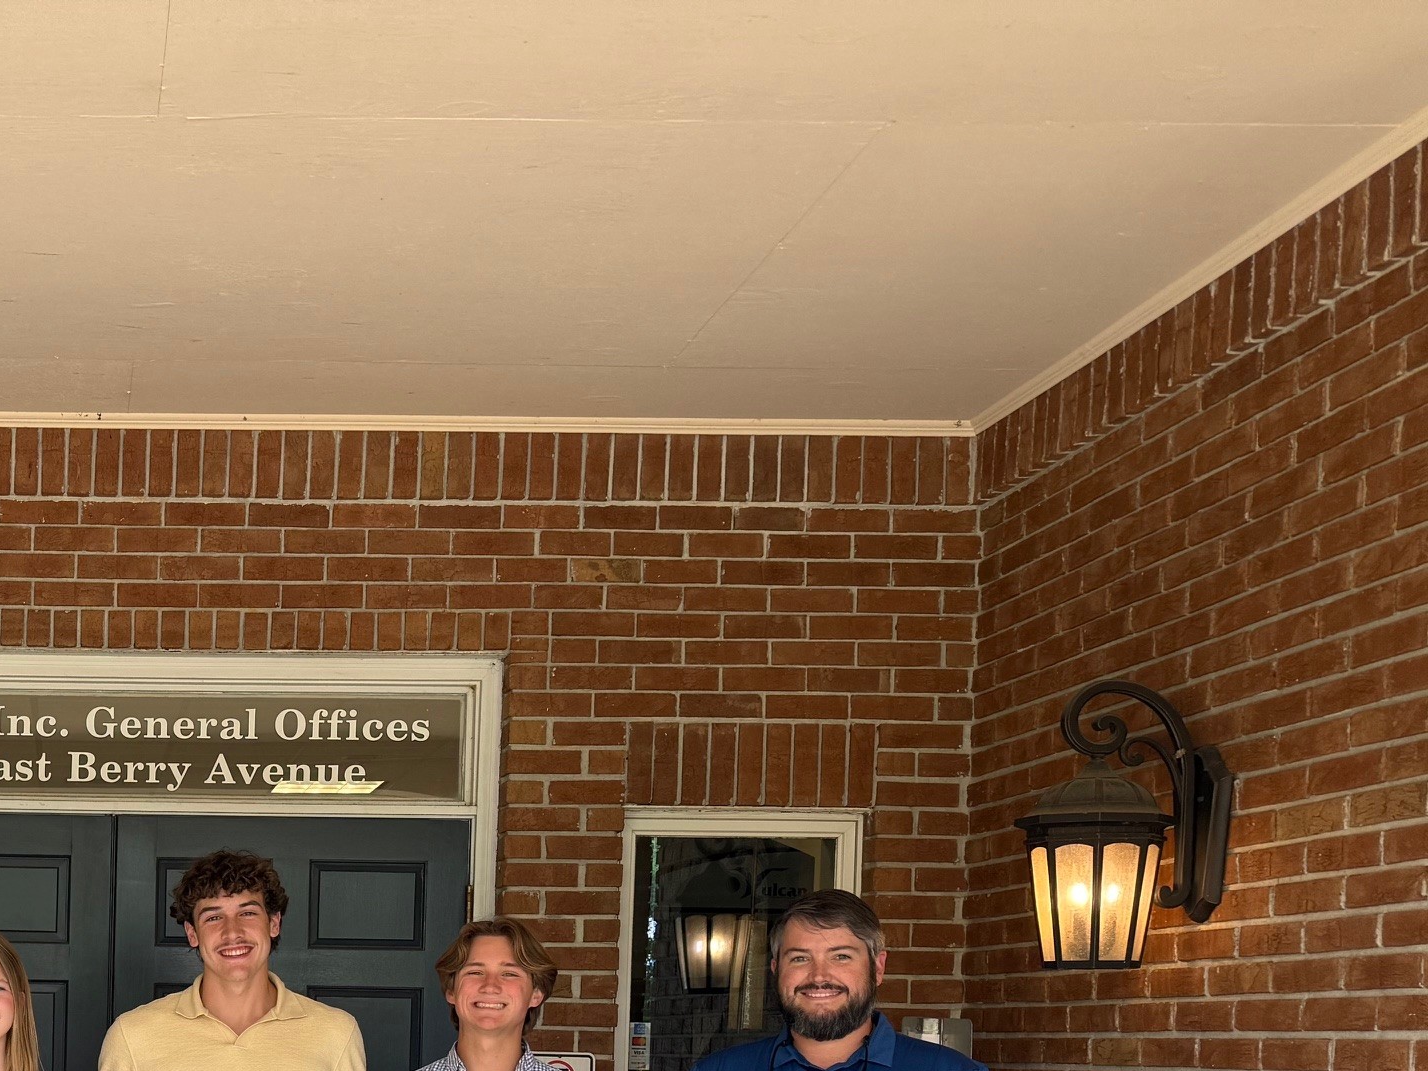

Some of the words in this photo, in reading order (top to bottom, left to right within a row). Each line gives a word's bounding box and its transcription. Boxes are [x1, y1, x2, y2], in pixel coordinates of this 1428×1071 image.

[85, 706, 259, 740] General
[274, 708, 431, 742] Offices
[66, 751, 192, 792] Berry
[204, 753, 367, 786] Avenue
